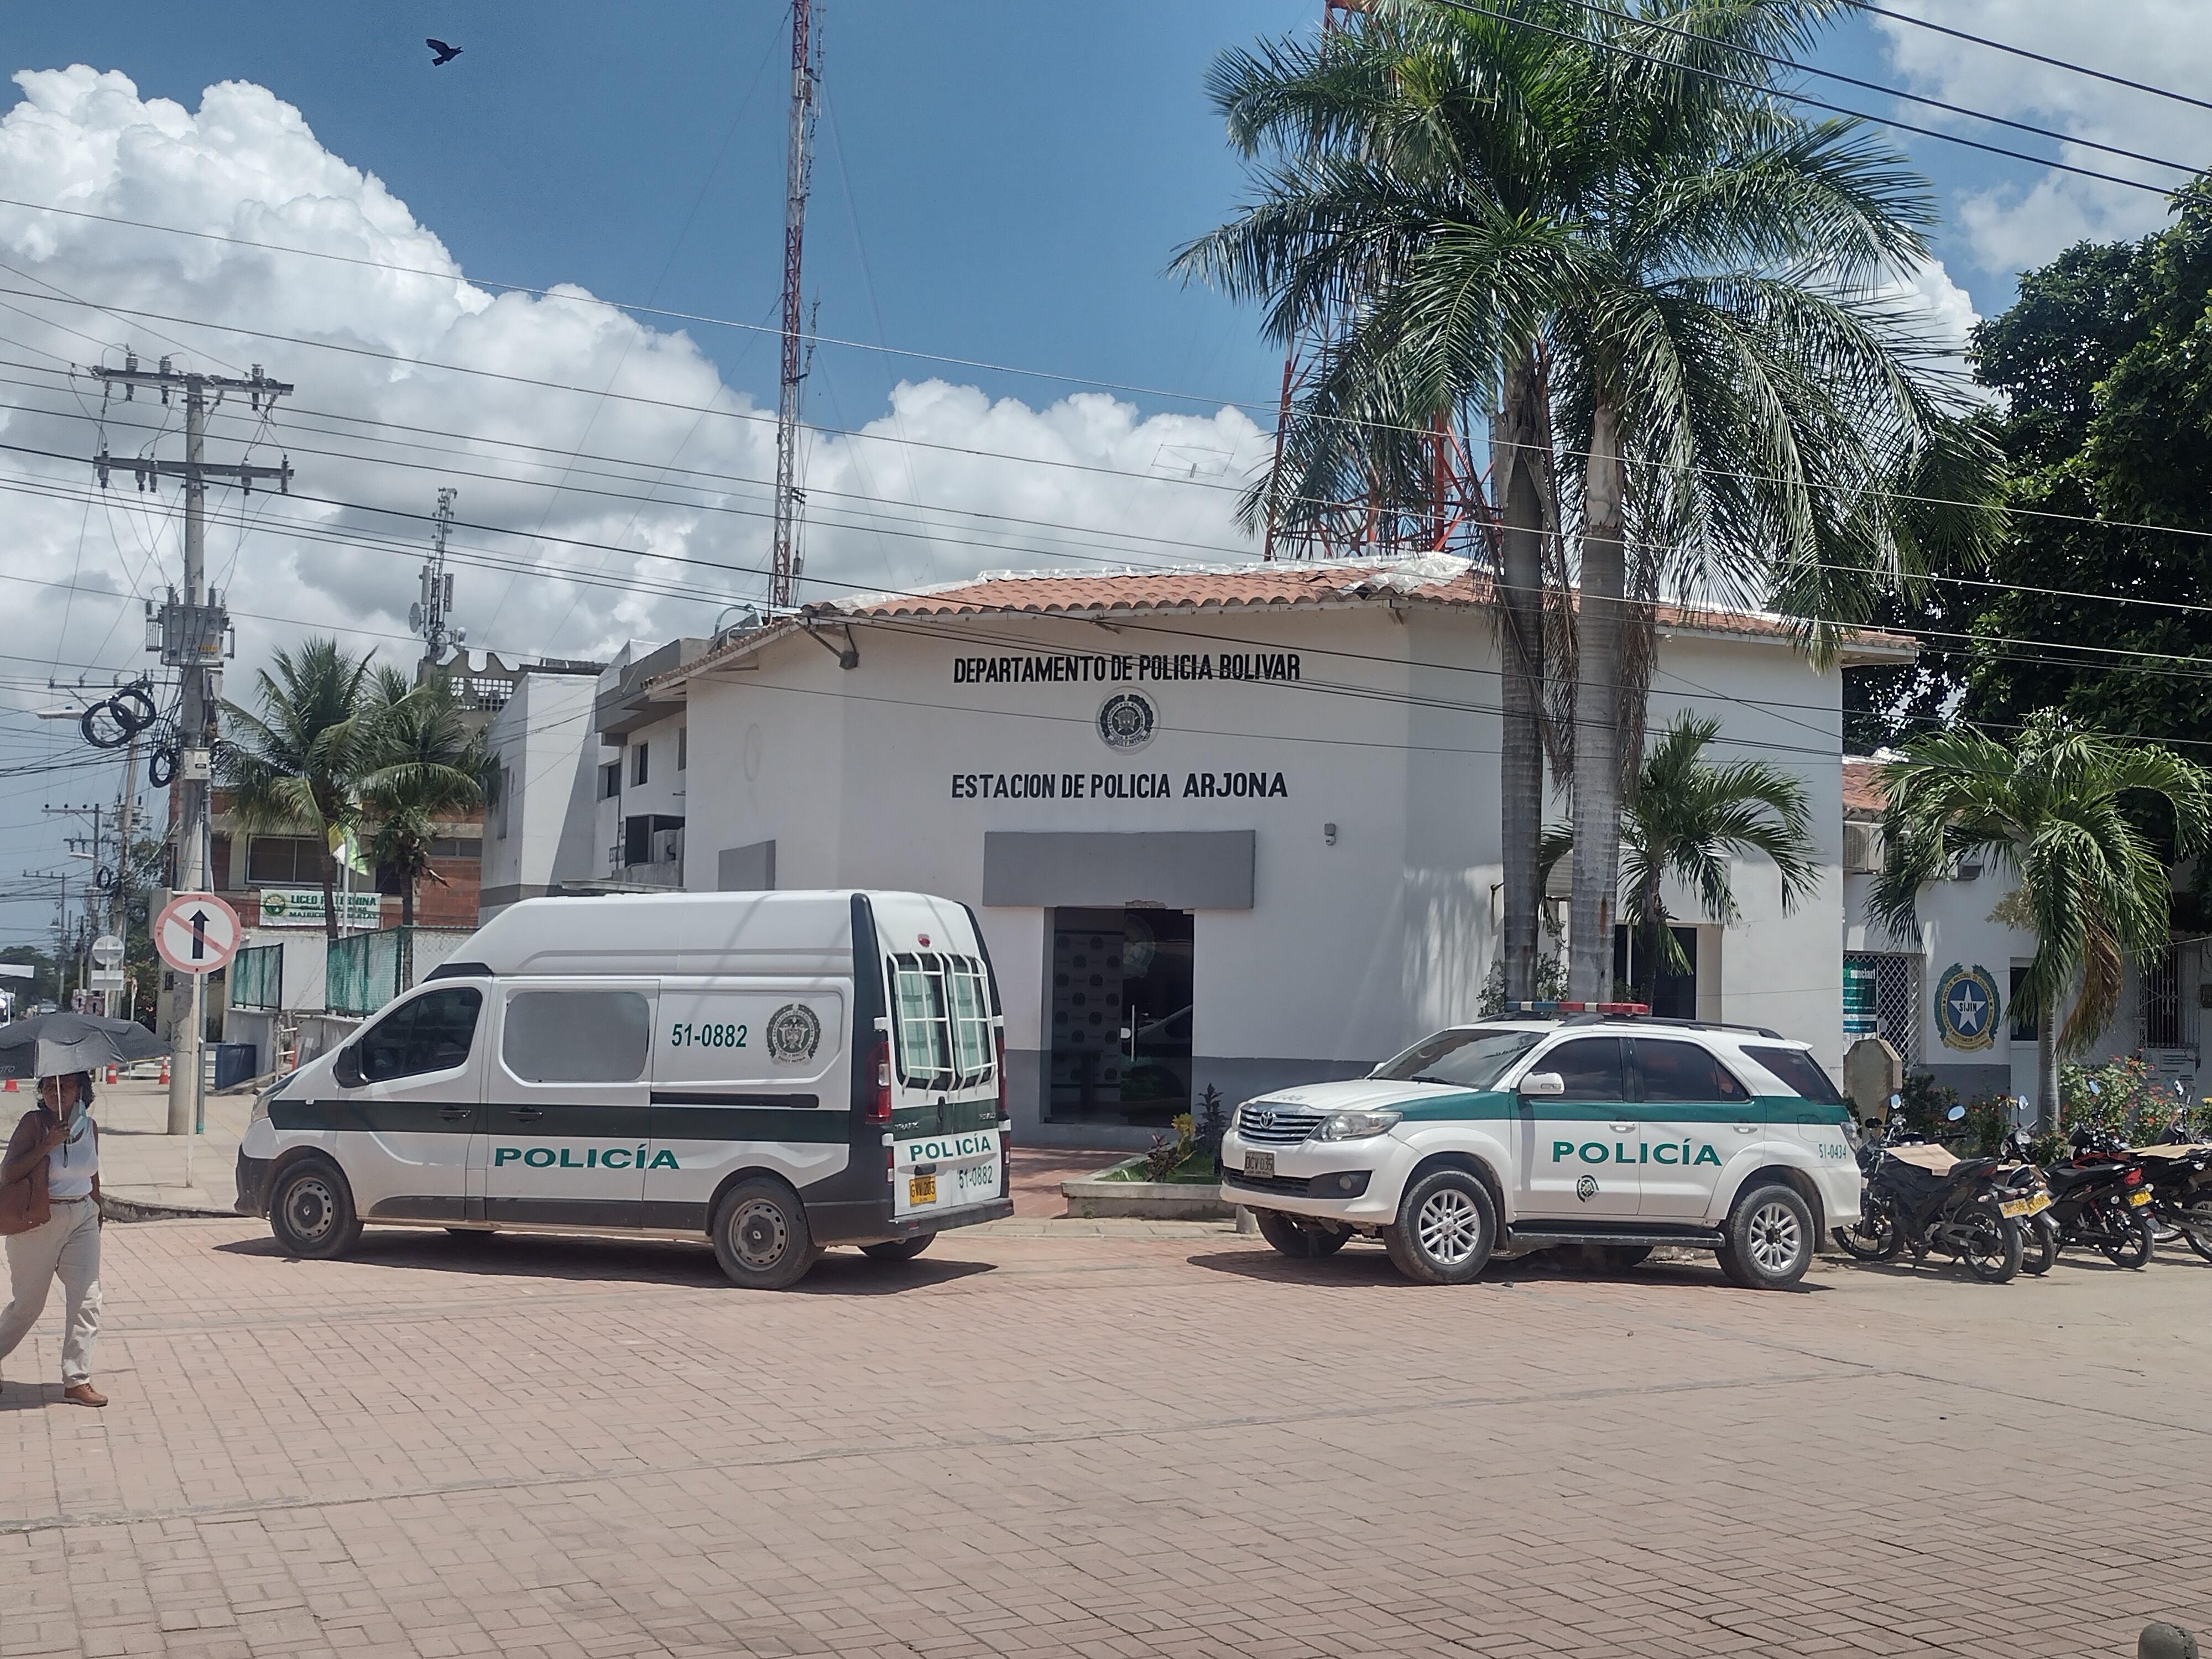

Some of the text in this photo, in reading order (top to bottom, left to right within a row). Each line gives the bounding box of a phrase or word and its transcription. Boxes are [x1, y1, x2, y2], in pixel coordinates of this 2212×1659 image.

[953, 654, 1301, 683] DEPARTAMENTO DE POLICIA BOLIVAR
[952, 772, 1288, 799] ESTACION DE POLICIA ARJONA
[291, 895, 317, 904] LICEO
[1959, 1002, 1977, 1011] SIJIN
[671, 1023, 747, 1047] 51-0882
[494, 1143, 680, 1170] POLICÍA
[910, 1133, 991, 1161] POLICÍA
[1552, 1138, 1722, 1166] POLICÍA
[1819, 1144, 1846, 1159] 51-0434
[959, 1166, 993, 1189] 51-0882
